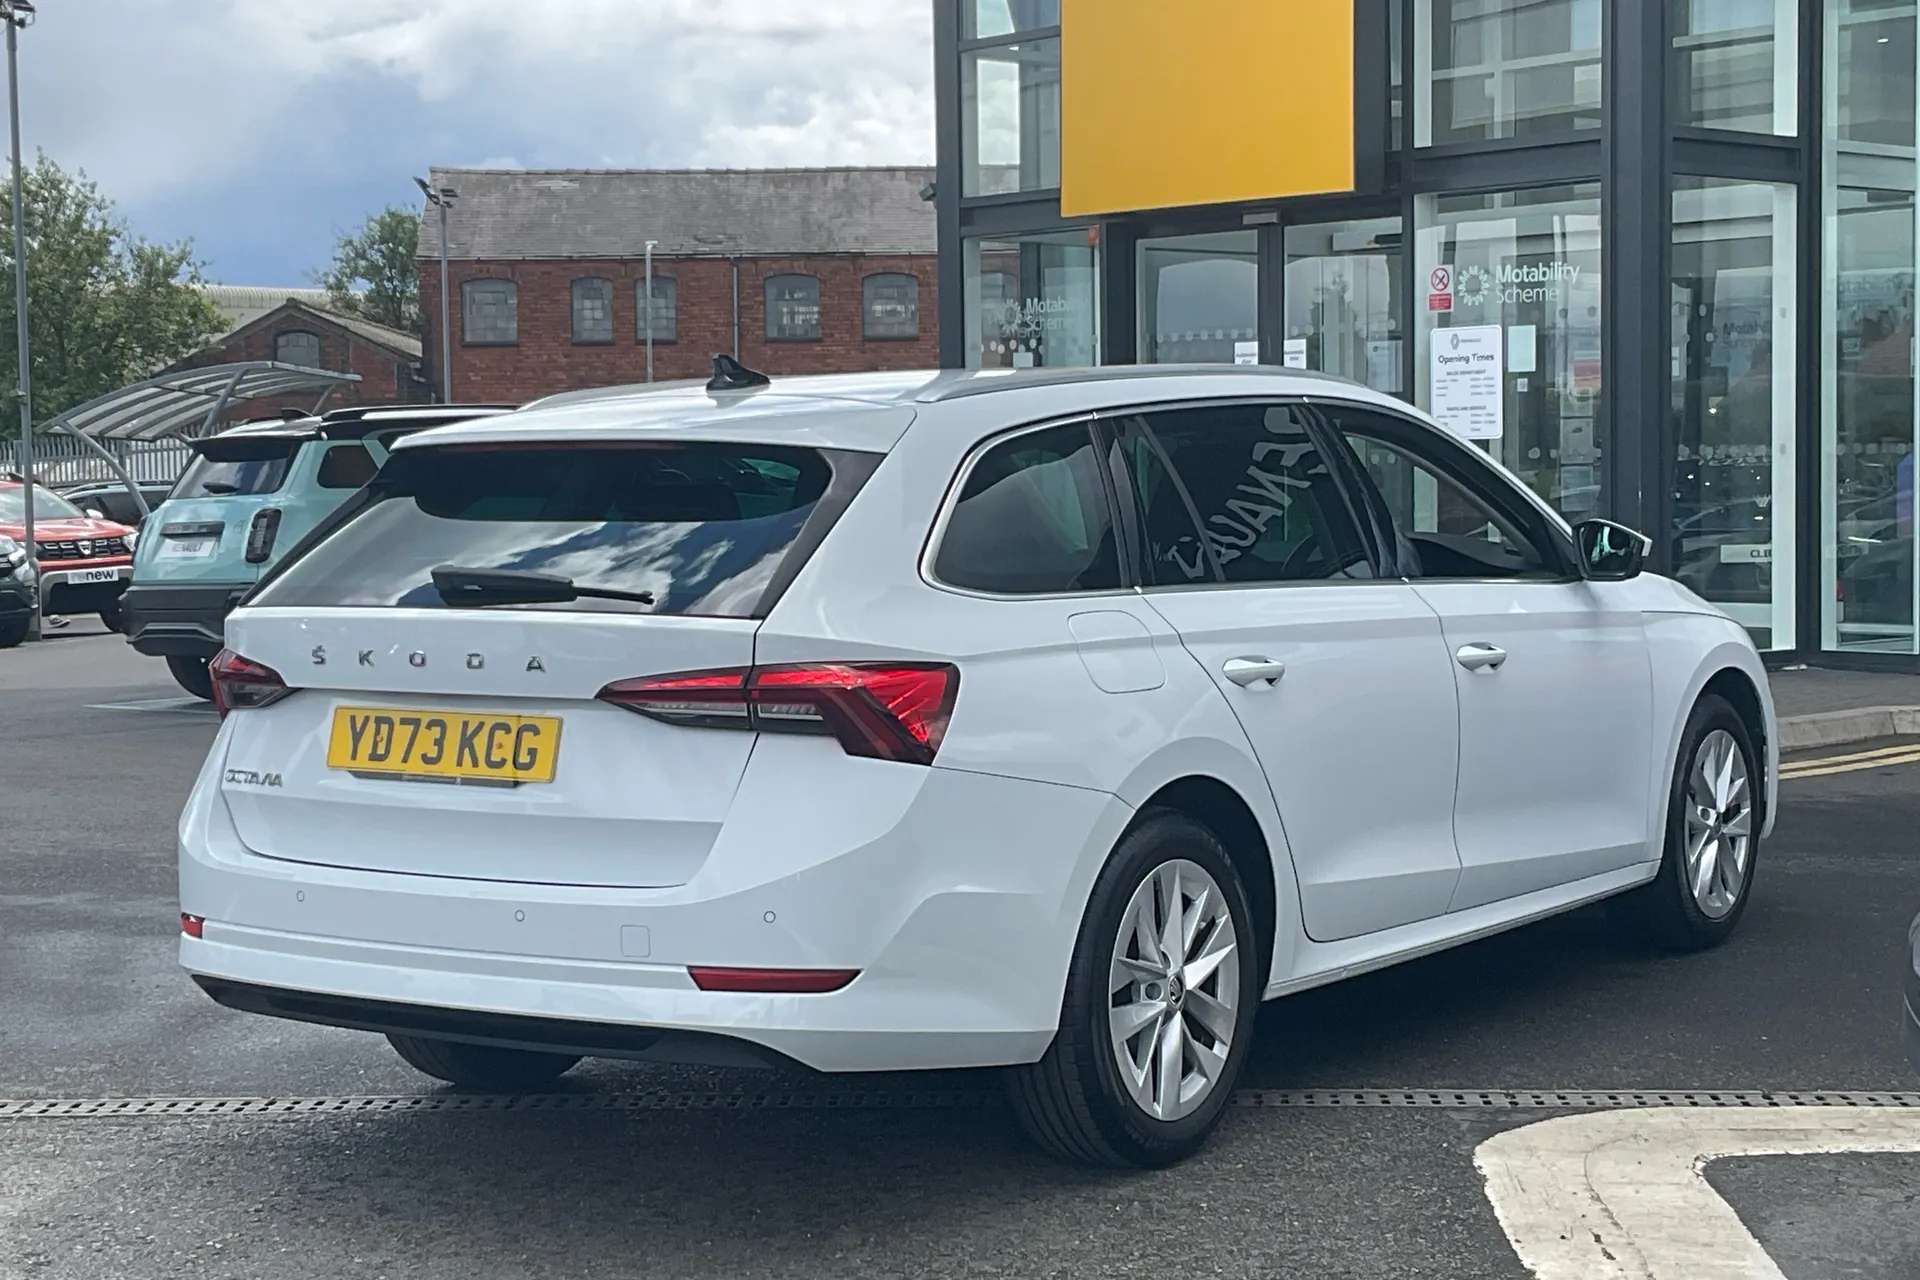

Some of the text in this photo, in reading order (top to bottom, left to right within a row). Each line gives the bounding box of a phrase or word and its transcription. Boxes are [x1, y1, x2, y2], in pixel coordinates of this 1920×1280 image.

[1495, 261, 1580, 284] Motability
[1495, 283, 1559, 304] Scheme
[1024, 315, 1069, 332] Schem
[1438, 352, 1495, 364] Opening Times
[86, 570, 114, 581] new
[349, 714, 541, 772] YD73 KCG
